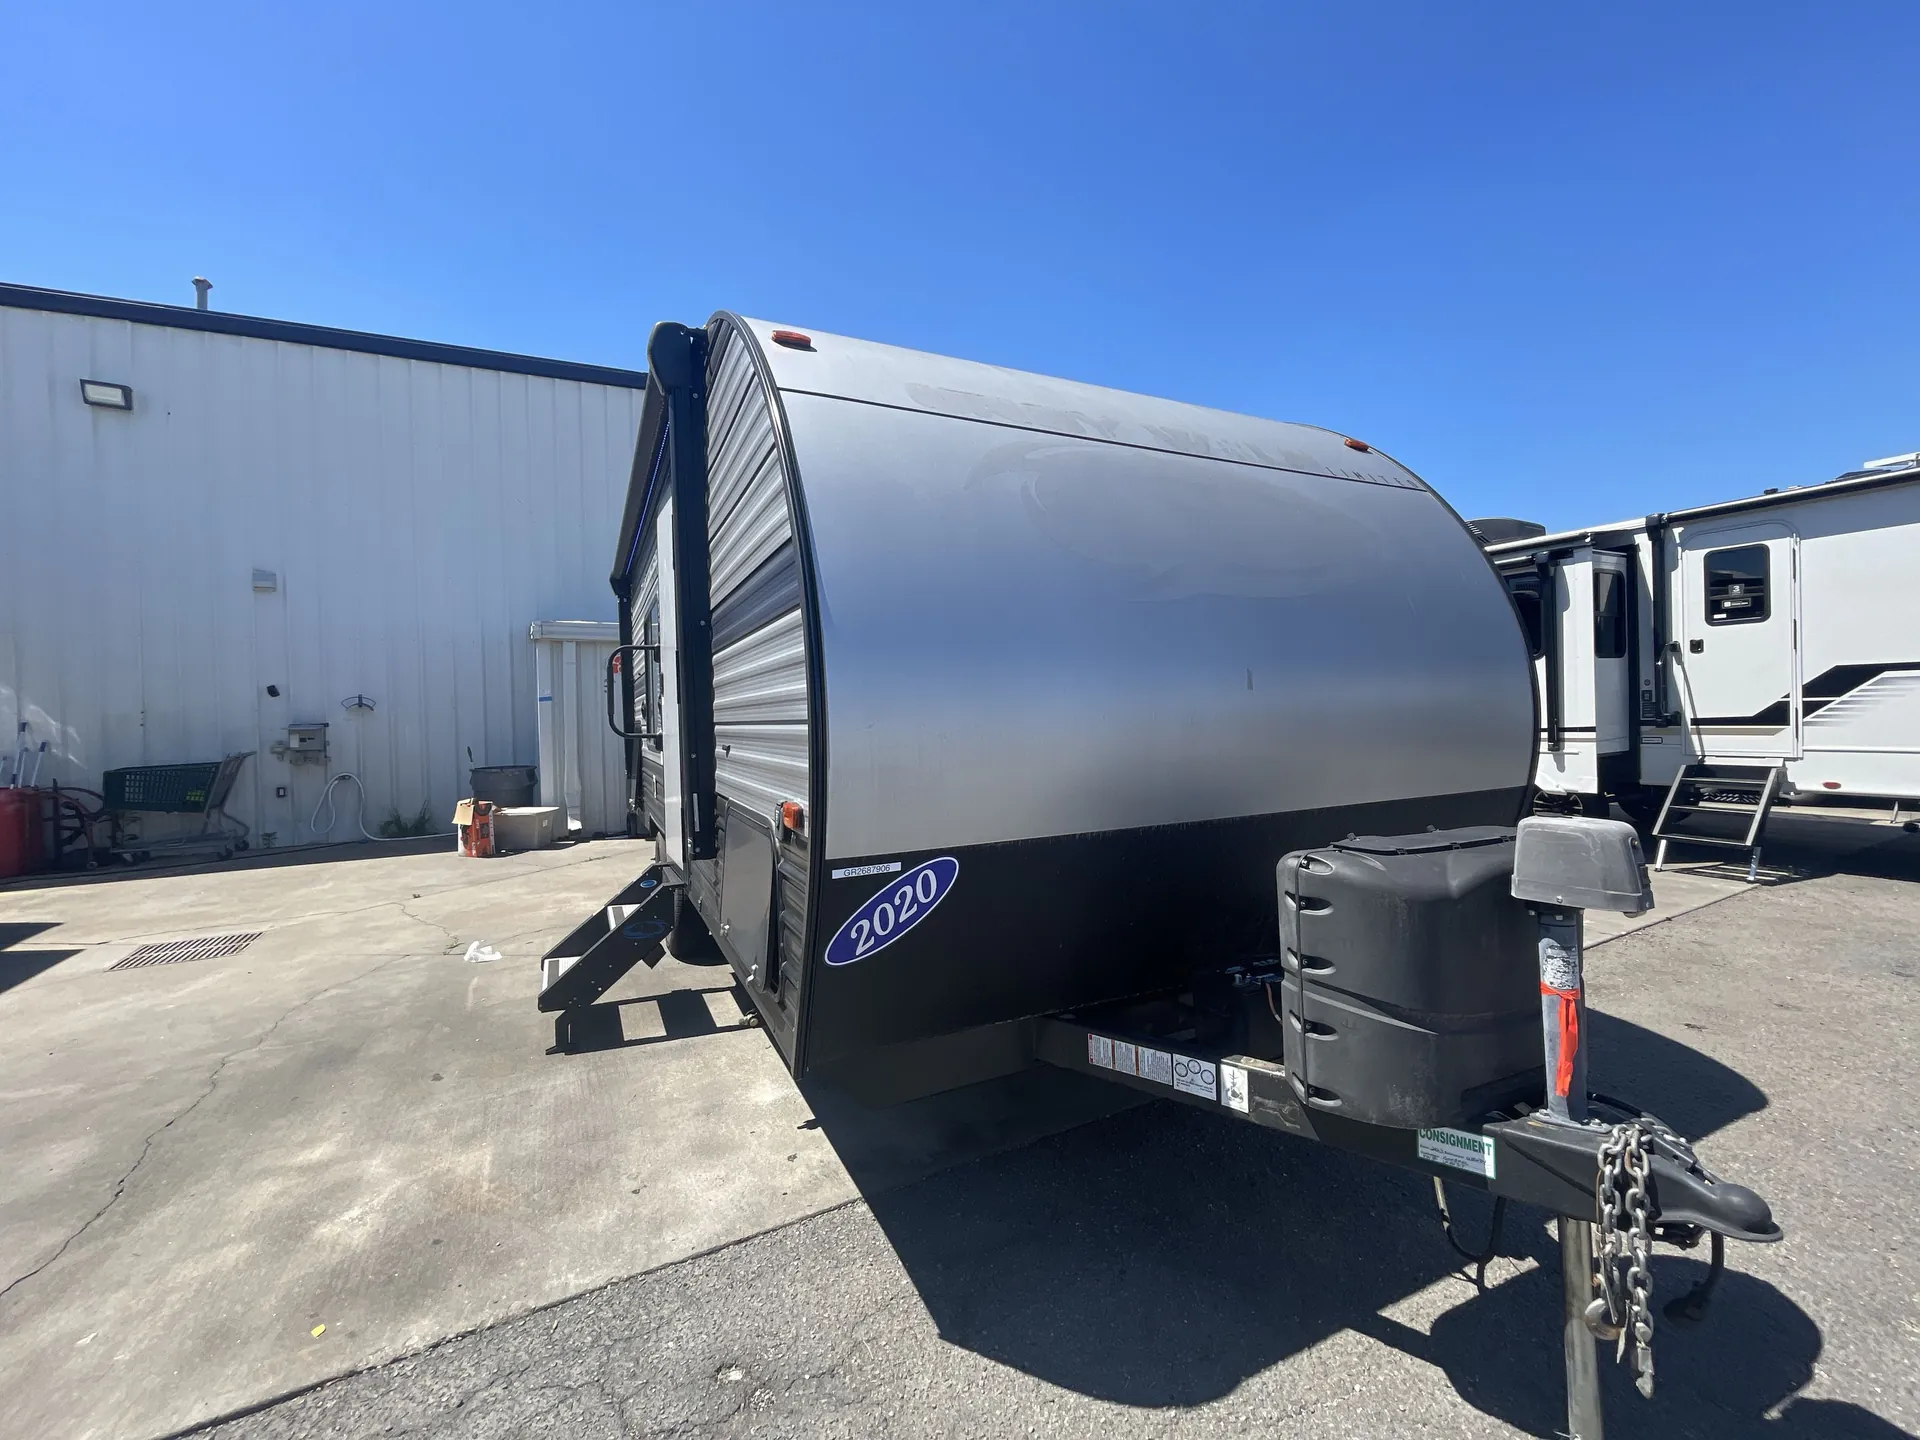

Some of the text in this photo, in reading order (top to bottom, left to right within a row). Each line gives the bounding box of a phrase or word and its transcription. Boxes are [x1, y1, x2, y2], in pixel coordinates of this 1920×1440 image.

[843, 864, 891, 877] GR2687906
[850, 869, 938, 956] 2020
[1419, 1128, 1492, 1156] CONSIGNMENT
